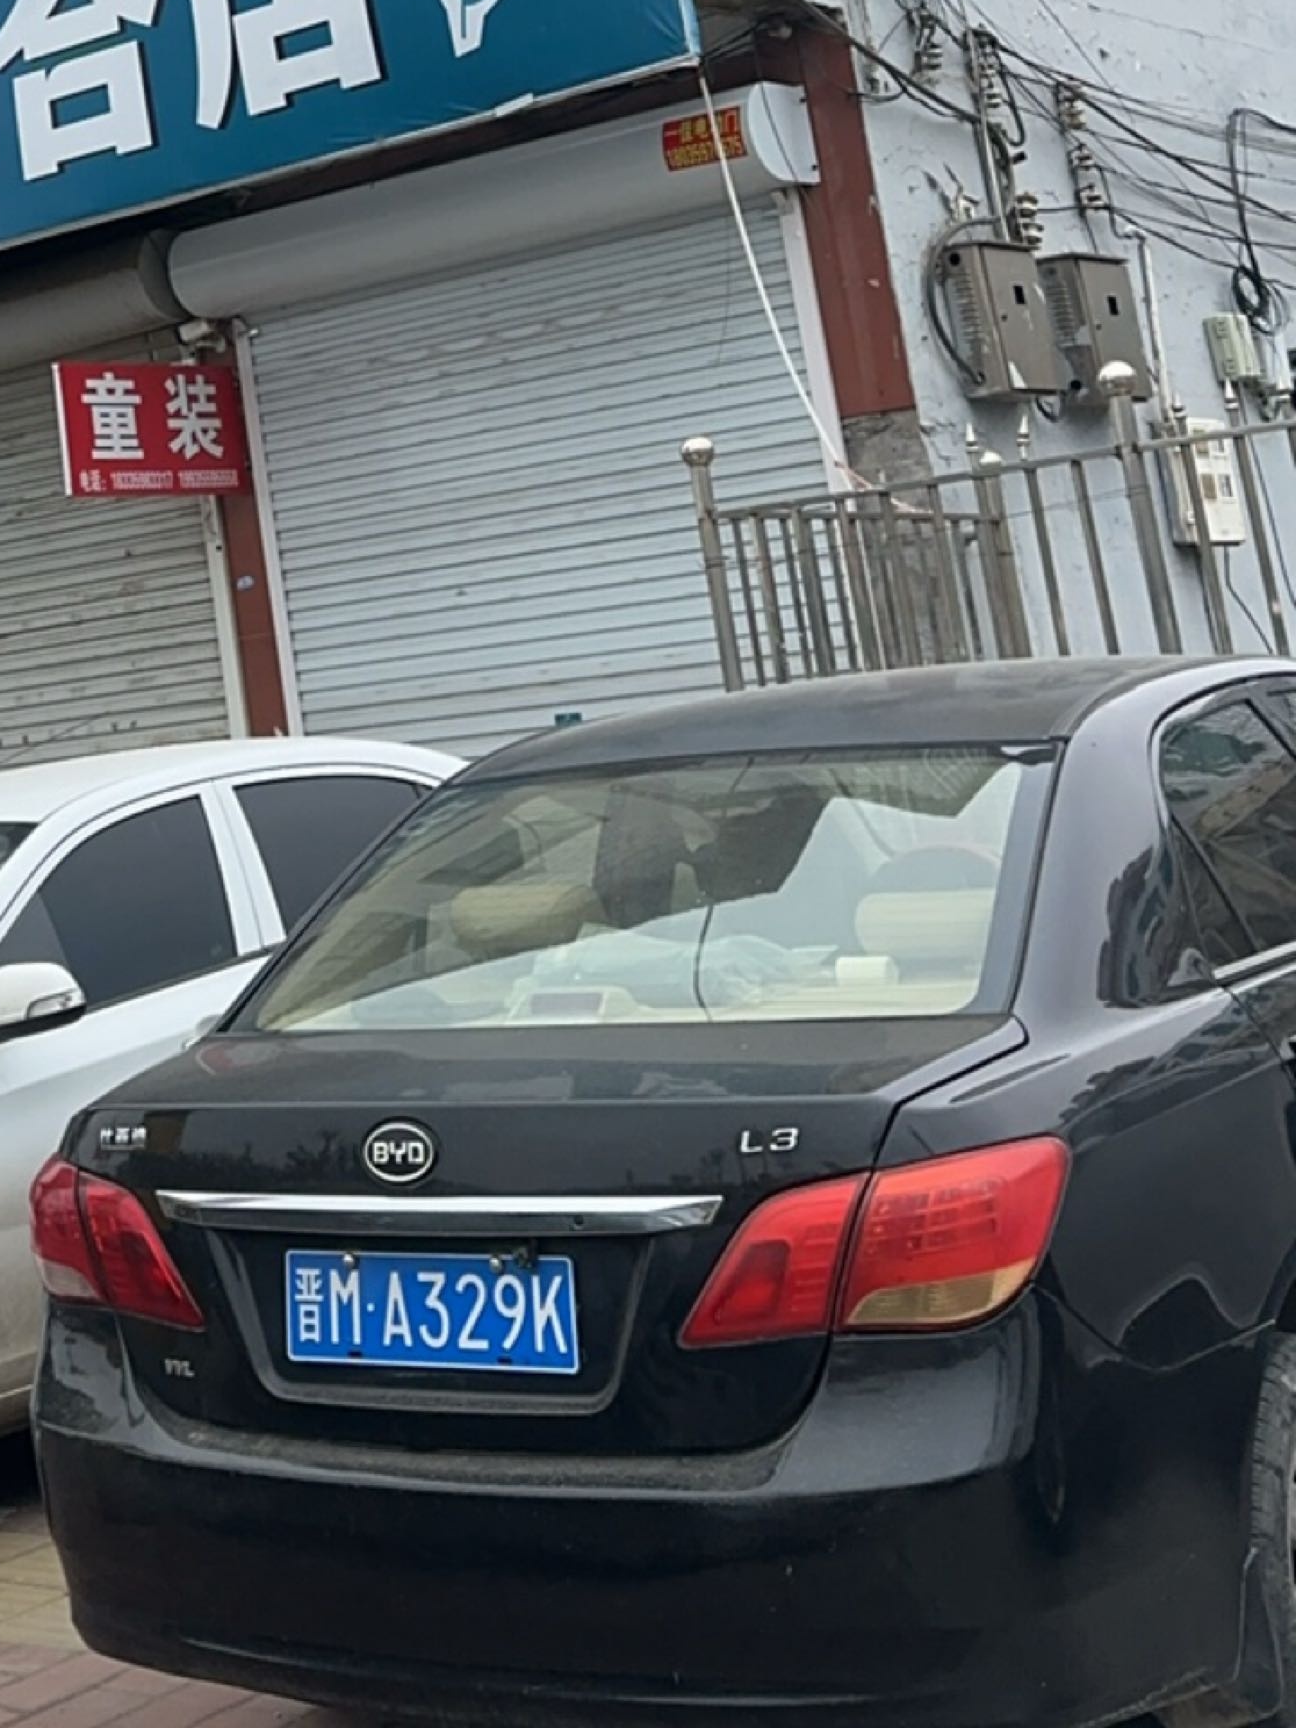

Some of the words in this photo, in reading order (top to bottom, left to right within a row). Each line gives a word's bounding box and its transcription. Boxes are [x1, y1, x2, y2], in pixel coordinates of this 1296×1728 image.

[80, 371, 225, 461] 童装
[372, 1140, 425, 1165] BYD
[740, 1127, 799, 1153] L3
[294, 1267, 569, 1355] 晋M·A329K
